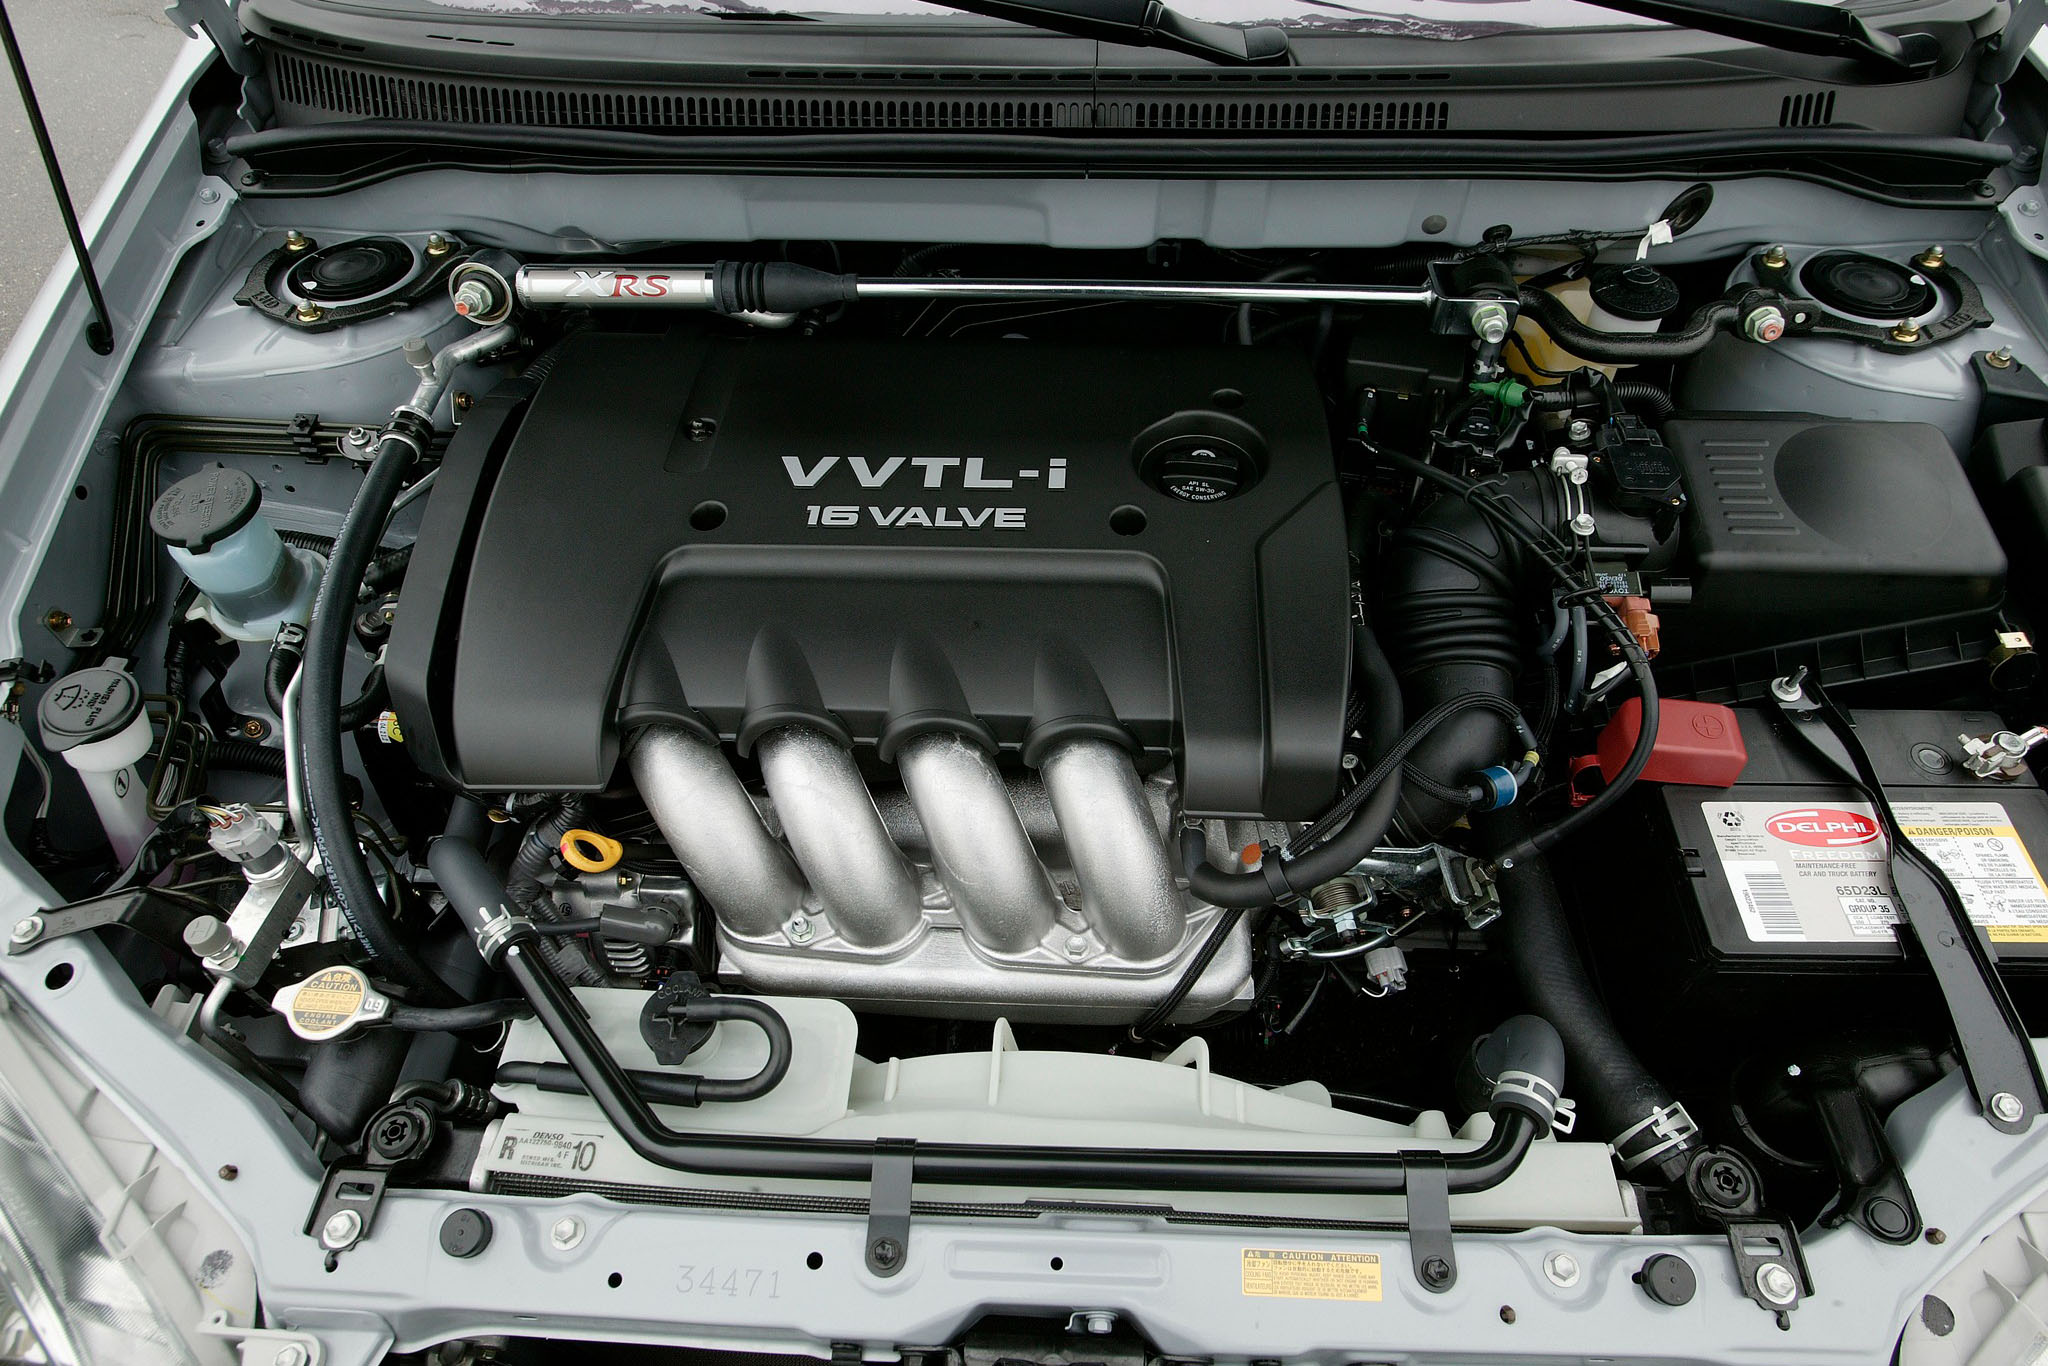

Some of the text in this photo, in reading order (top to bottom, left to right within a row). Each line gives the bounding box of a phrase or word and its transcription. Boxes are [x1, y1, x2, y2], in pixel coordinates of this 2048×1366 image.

[566, 270, 671, 297] XRS
[781, 456, 1067, 489] VVTL-i
[1169, 485, 1227, 500] ENERGY CONSERVING
[1195, 486, 1215, 494] 5W-30
[807, 505, 1027, 528] 16 VALVE
[84, 678, 121, 727] WASHER FLUID
[1775, 821, 1868, 834] DELPHI
[1915, 827, 1994, 836] DANGER/POISON
[1789, 849, 1881, 859] FREEDOM
[1850, 870, 1877, 878] BATTERY
[1835, 885, 1888, 895] 65D23L
[1848, 904, 1891, 913] GROUP 35
[310, 980, 358, 992] CAUTION
[299, 1016, 338, 1025] COOLANT
[304, 1012, 338, 1020] ENGINE
[532, 1131, 564, 1140] DENSO
[498, 1135, 518, 1160] R
[571, 1140, 597, 1171] 10
[1281, 1252, 1324, 1261] CAUTION
[1330, 1254, 1377, 1263] ATTENTION
[676, 1265, 781, 1299] 34471
